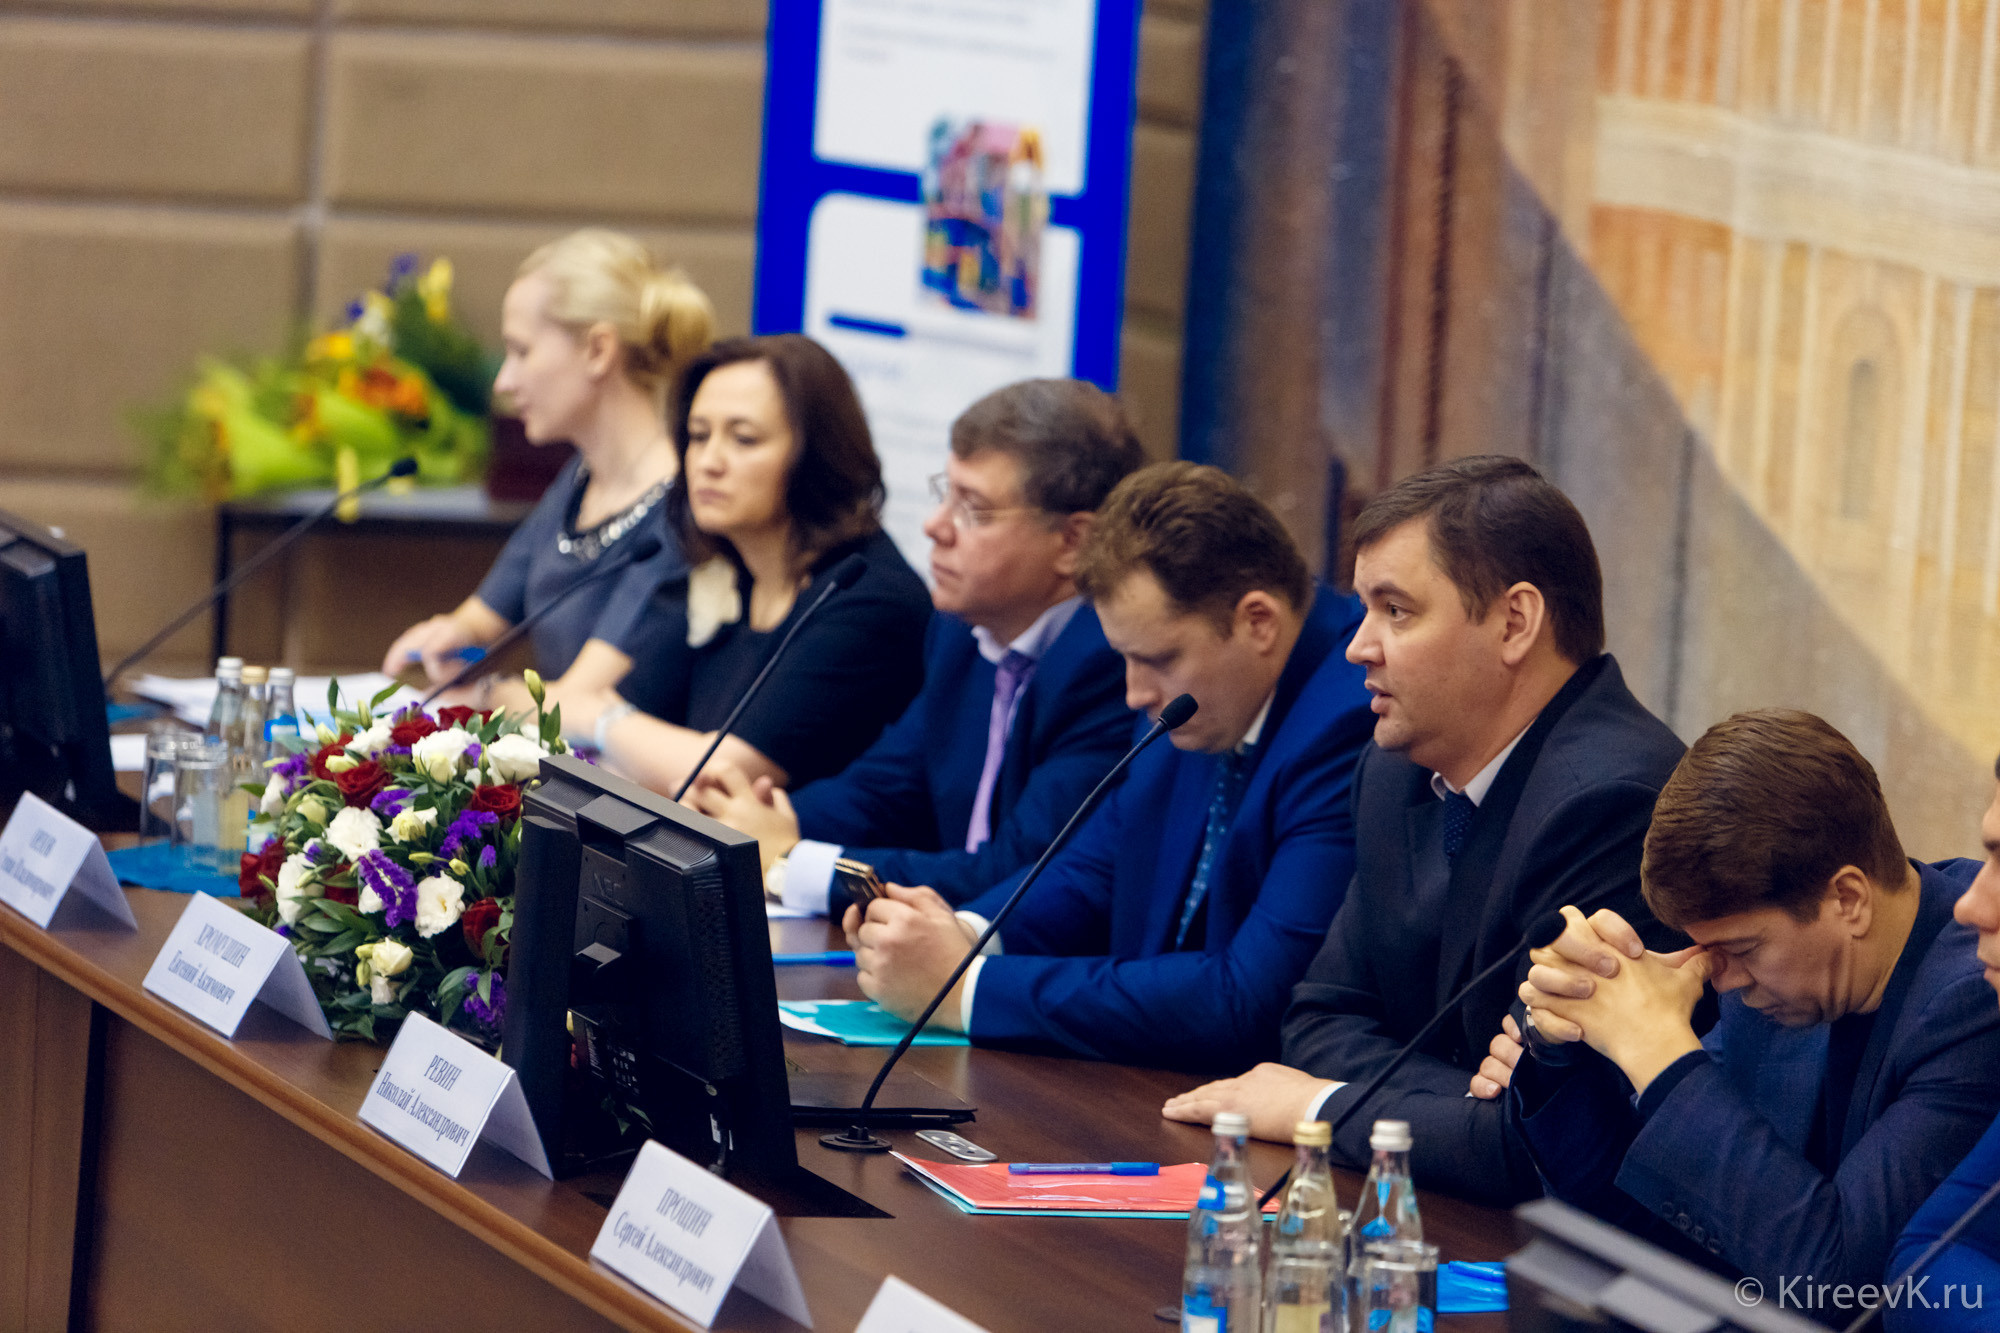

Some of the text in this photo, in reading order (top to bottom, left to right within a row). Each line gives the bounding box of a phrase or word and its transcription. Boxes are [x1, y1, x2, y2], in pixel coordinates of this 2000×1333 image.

[376, 1071, 470, 1147] Николай Александрович
[424, 1055, 462, 1092] РЕВИН
[613, 1210, 715, 1295] Сергей Александрович
